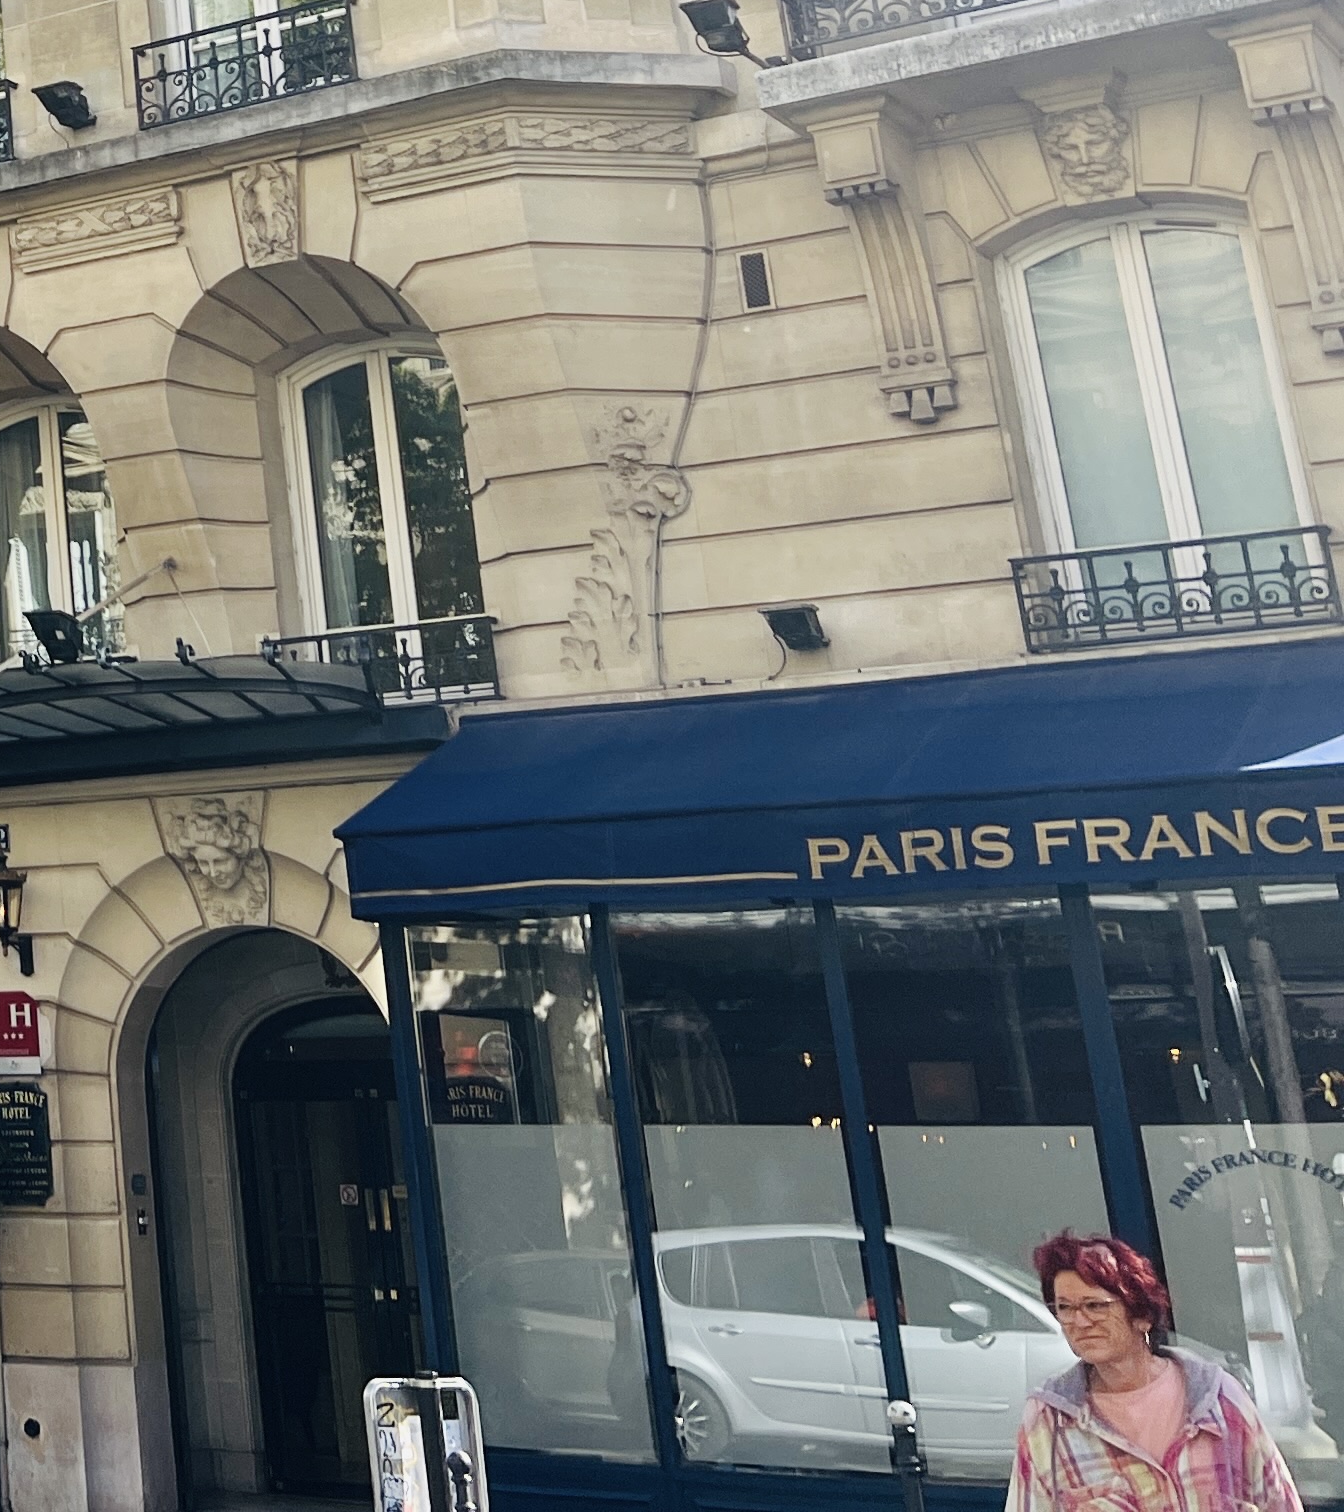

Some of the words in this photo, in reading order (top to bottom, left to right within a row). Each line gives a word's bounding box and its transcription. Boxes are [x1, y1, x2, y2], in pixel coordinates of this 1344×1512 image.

[806, 824, 1014, 880] PARIS
[1033, 806, 1344, 865] FRANCE
[8, 1002, 32, 1028] H
[1169, 1165, 1212, 1210] PARIS
[1210, 1148, 1297, 1175] FRANCE
